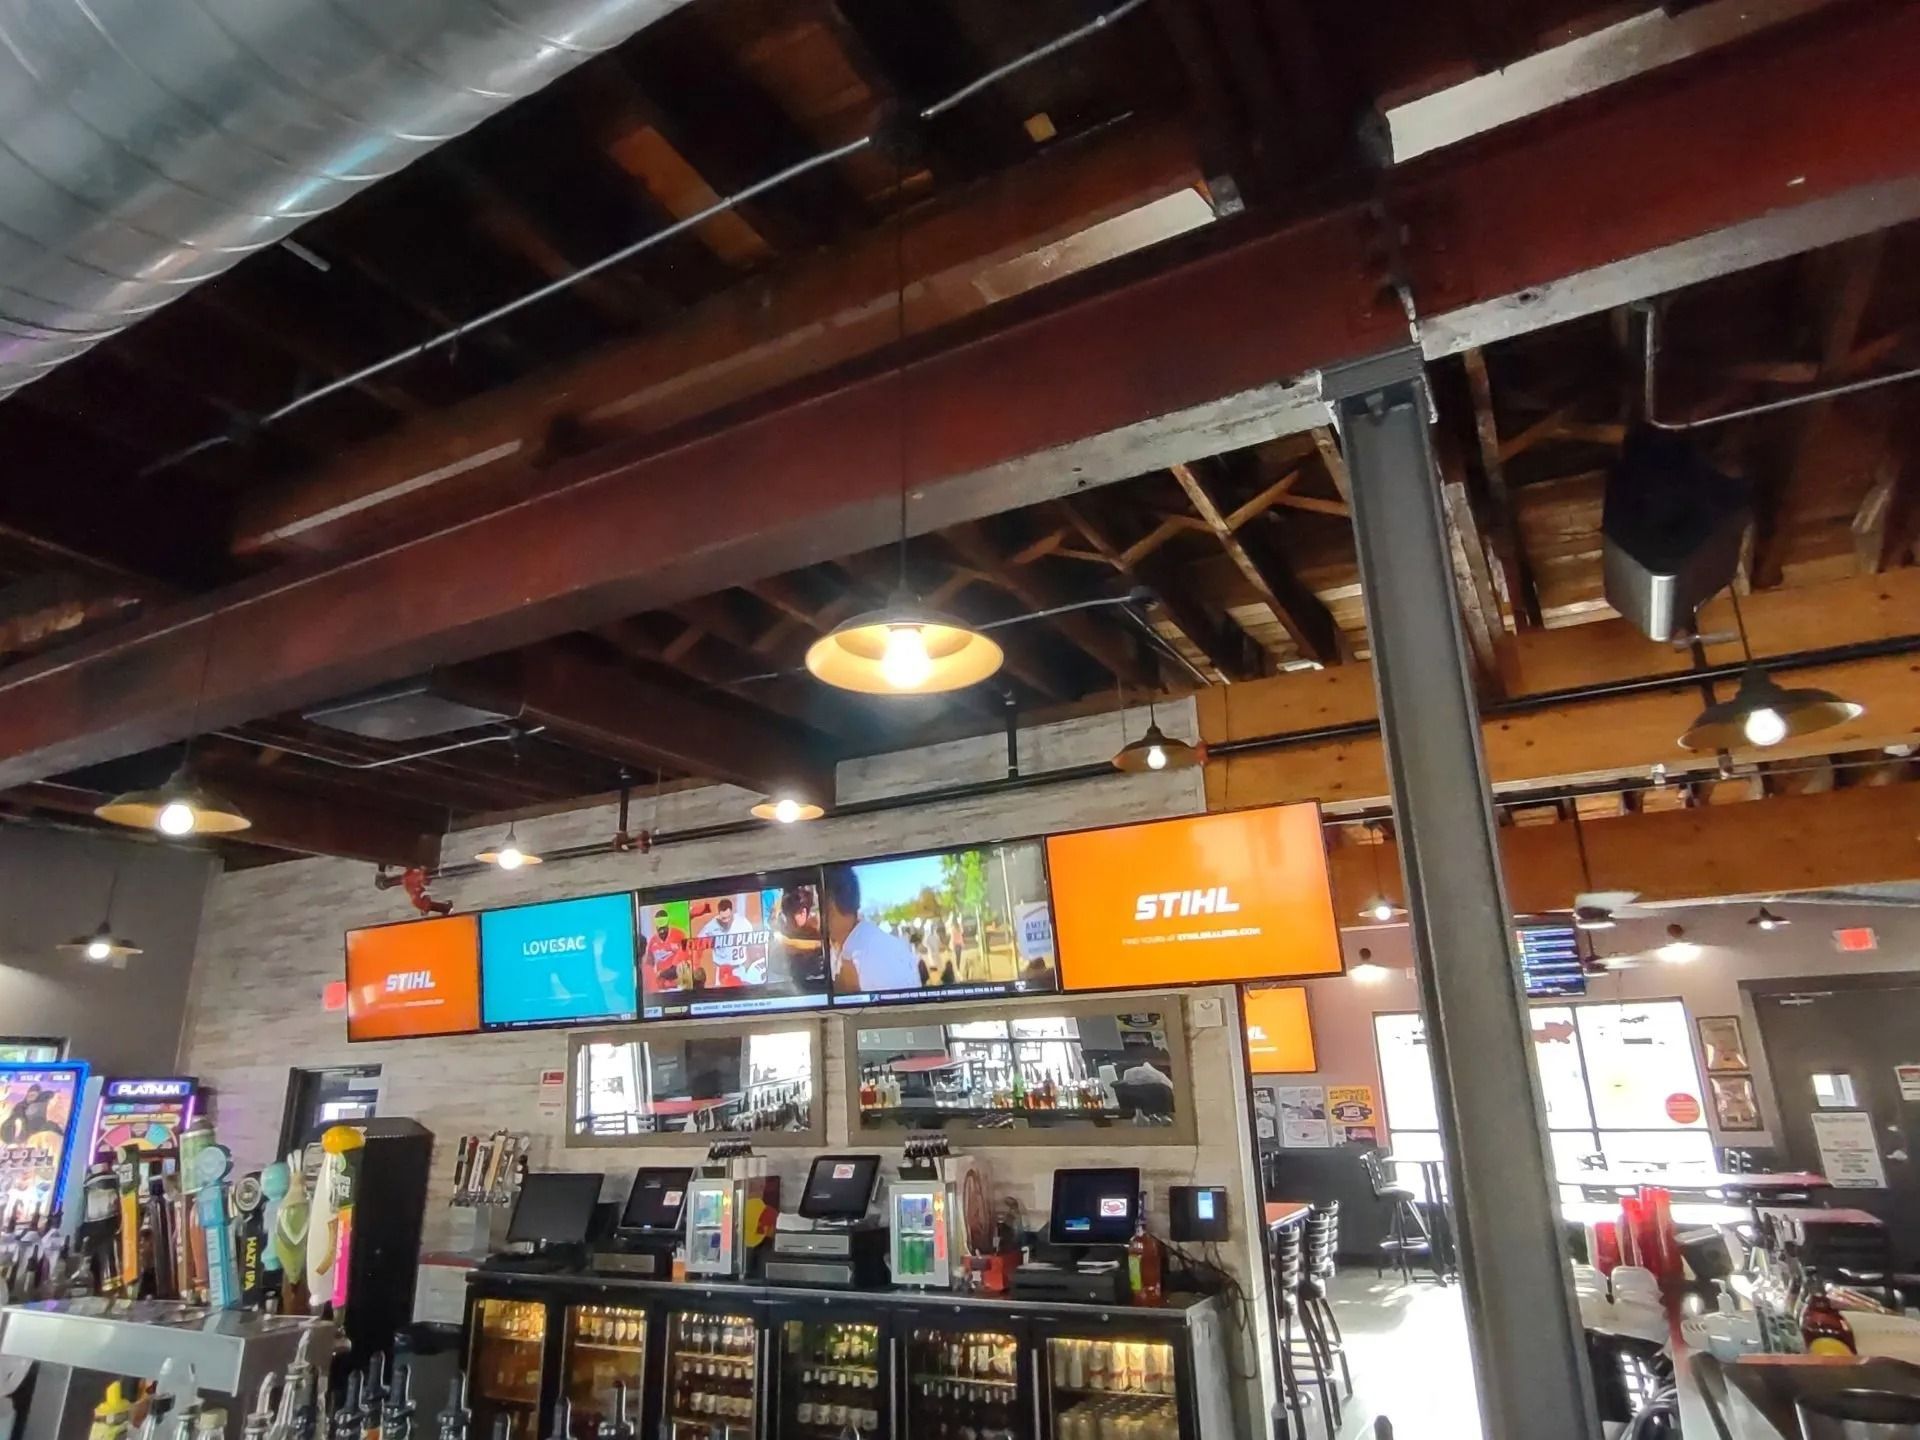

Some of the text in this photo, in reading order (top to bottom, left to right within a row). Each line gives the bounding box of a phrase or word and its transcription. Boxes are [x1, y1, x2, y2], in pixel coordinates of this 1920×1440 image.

[1134, 886, 1240, 921] STIHL
[522, 935, 587, 956] LOVESAC
[736, 930, 770, 946] PLAYER
[385, 970, 436, 992] STIHL
[117, 1084, 180, 1095] PLATINUM
[244, 1236, 257, 1291] HAZY IPA
